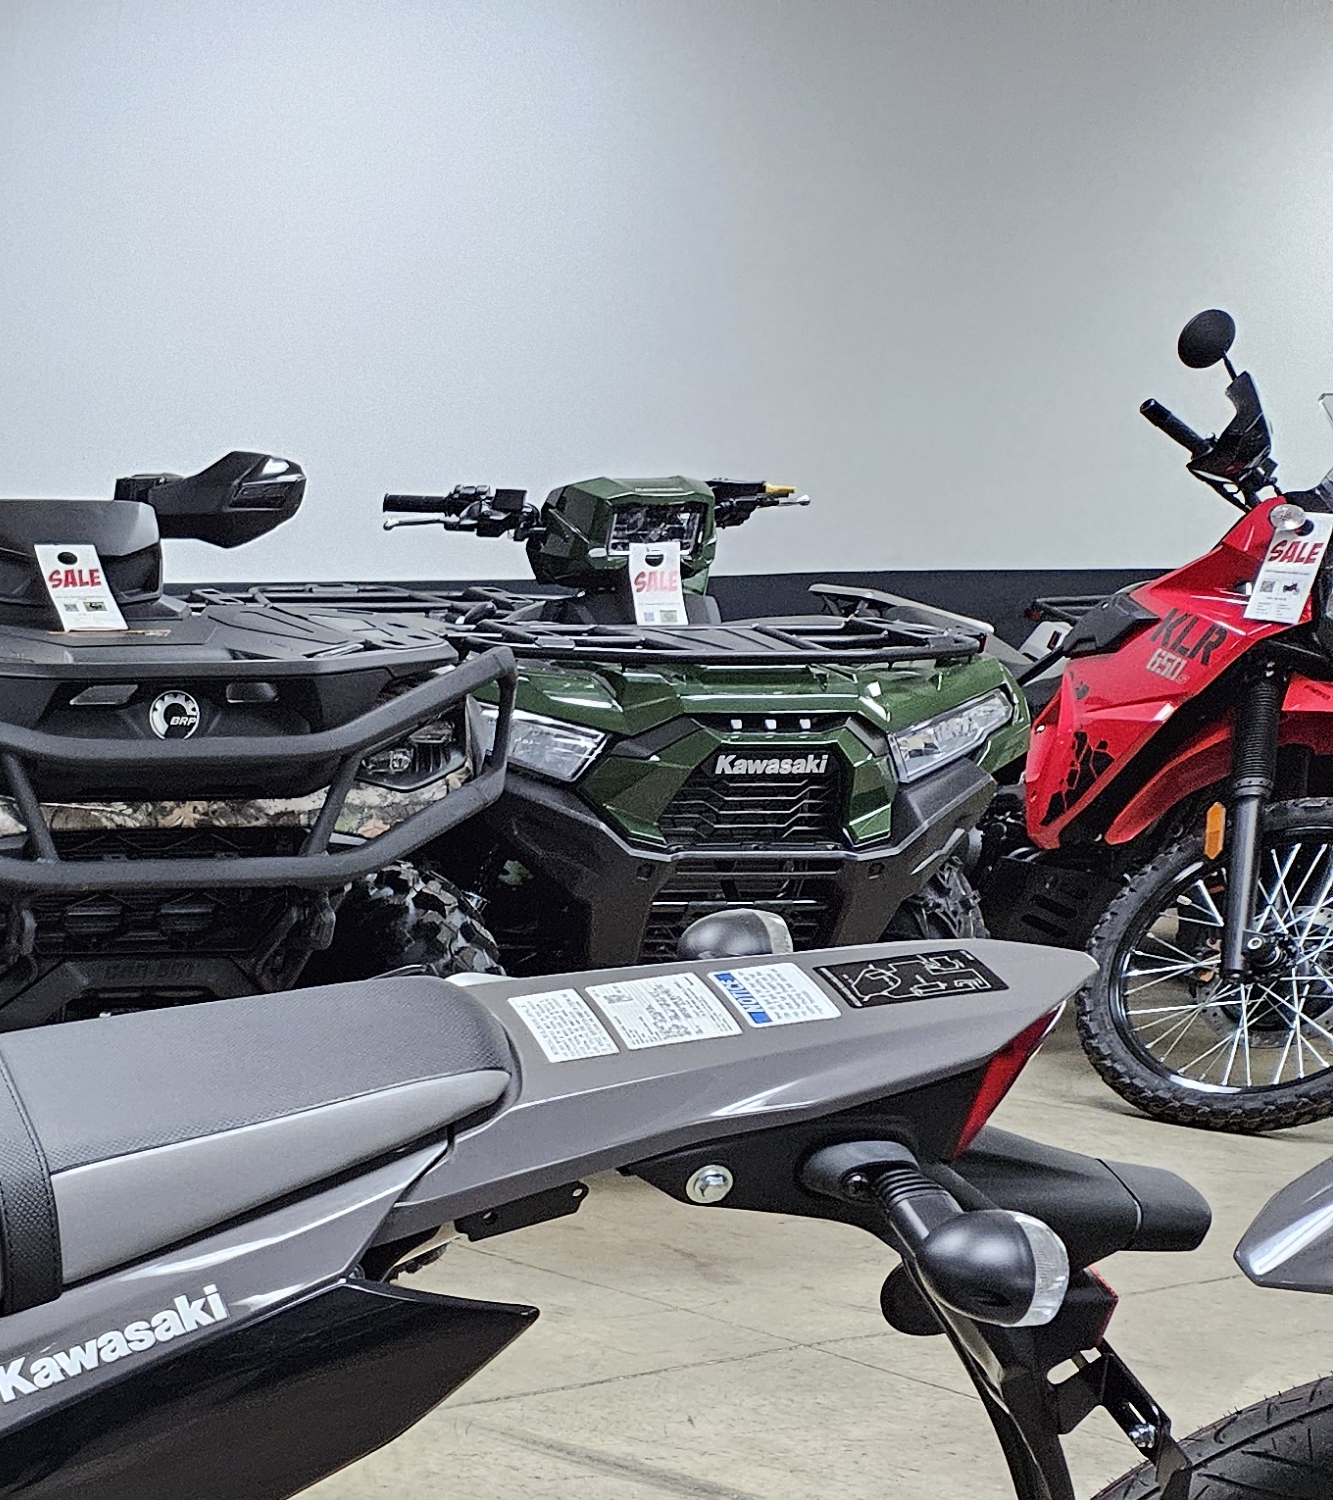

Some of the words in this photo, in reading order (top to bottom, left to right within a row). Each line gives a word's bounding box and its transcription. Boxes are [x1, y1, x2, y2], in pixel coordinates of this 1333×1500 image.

[1268, 539, 1324, 564] SALE
[48, 568, 102, 589] SALE
[634, 570, 678, 593] SALE
[1149, 607, 1227, 667] KLR
[169, 716, 197, 726] BRP
[714, 754, 829, 774] Kawasaki
